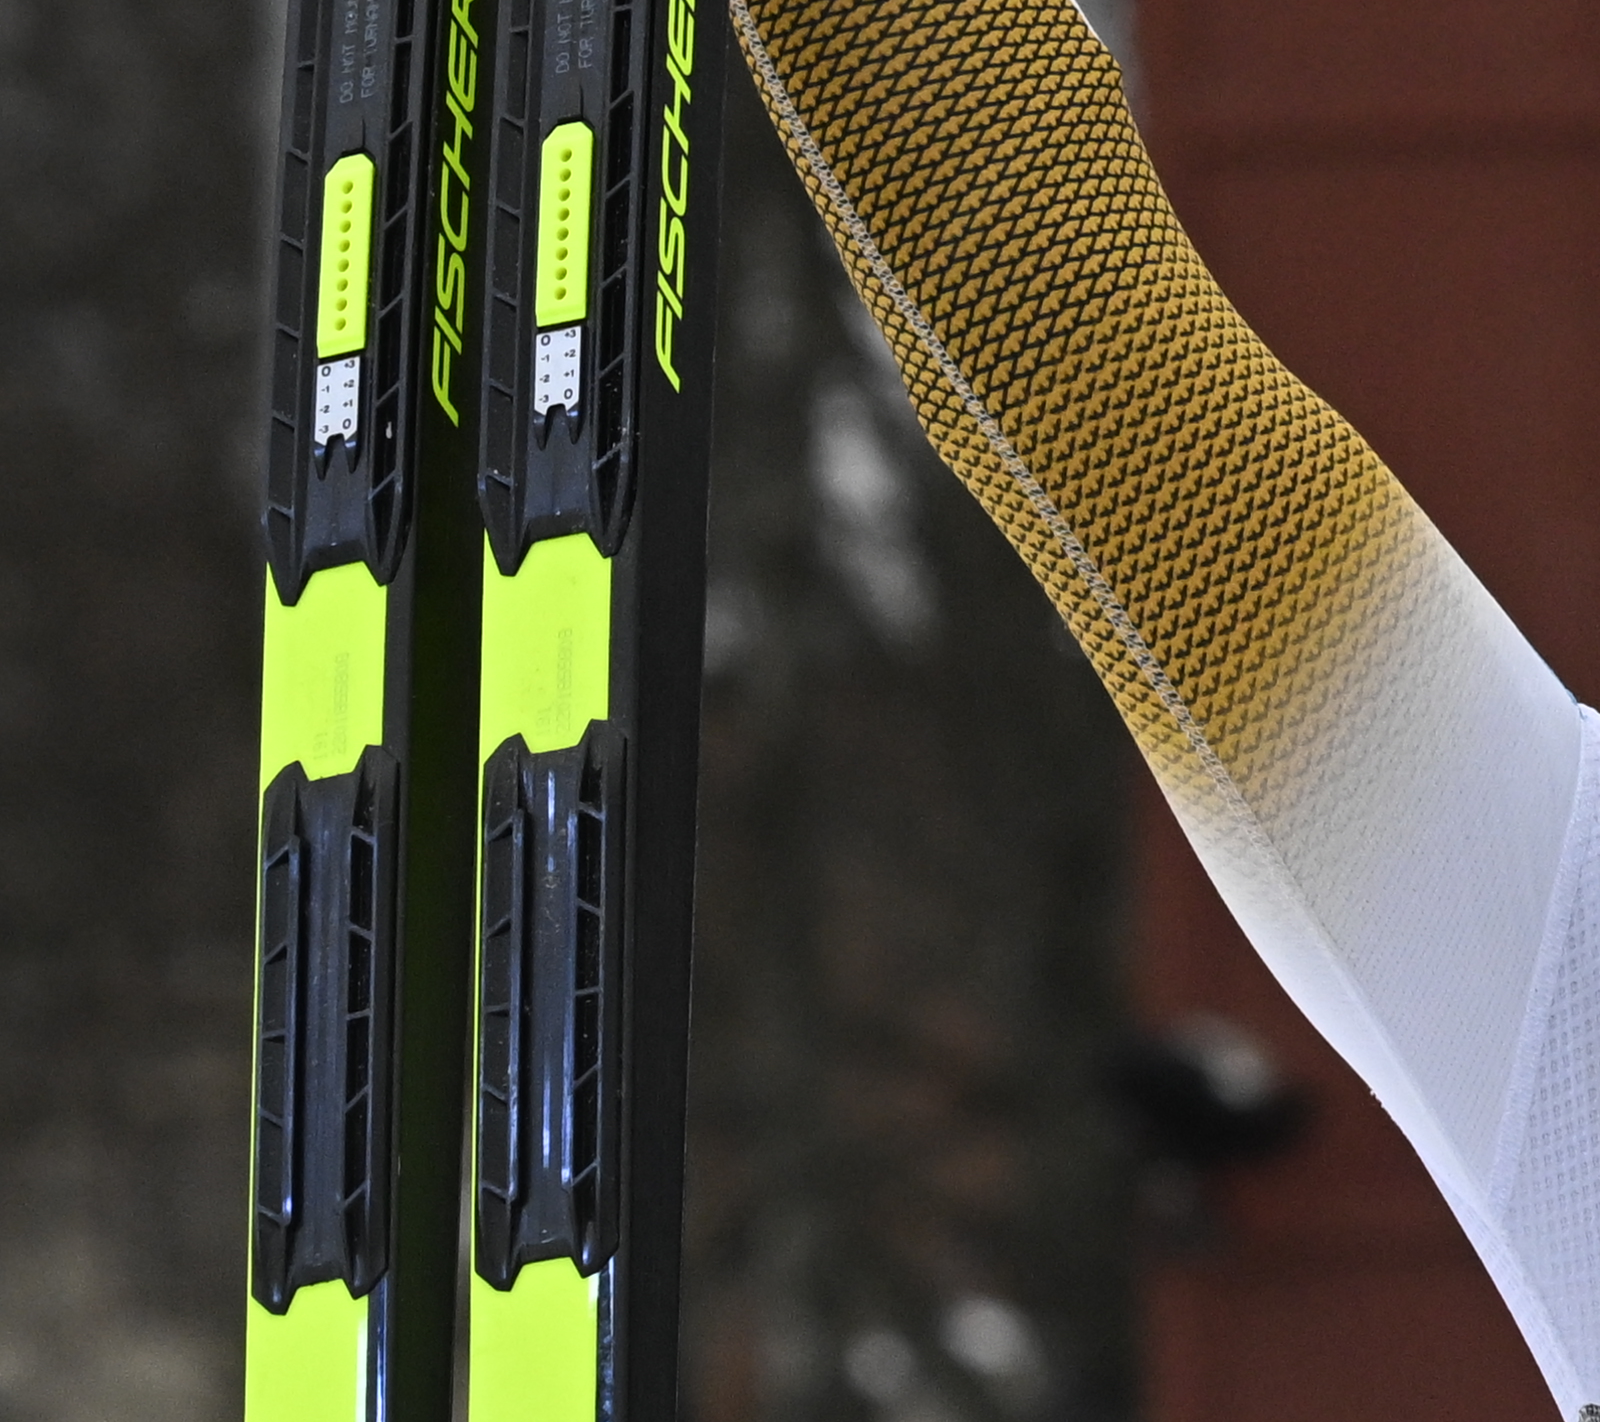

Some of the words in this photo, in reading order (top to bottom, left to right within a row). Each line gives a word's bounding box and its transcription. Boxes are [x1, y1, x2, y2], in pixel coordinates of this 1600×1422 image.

[541, 335, 550, 346] 0
[564, 329, 576, 338] +3
[564, 349, 576, 358] +2
[321, 366, 331, 377] 0
[344, 359, 355, 369] +3
[539, 374, 550, 383] -2
[563, 370, 575, 378] +1
[344, 379, 355, 388] +2
[538, 394, 549, 403] -3
[564, 389, 573, 400] 0
[319, 404, 330, 414] -2
[343, 400, 354, 408] +1
[342, 419, 351, 430] 0
